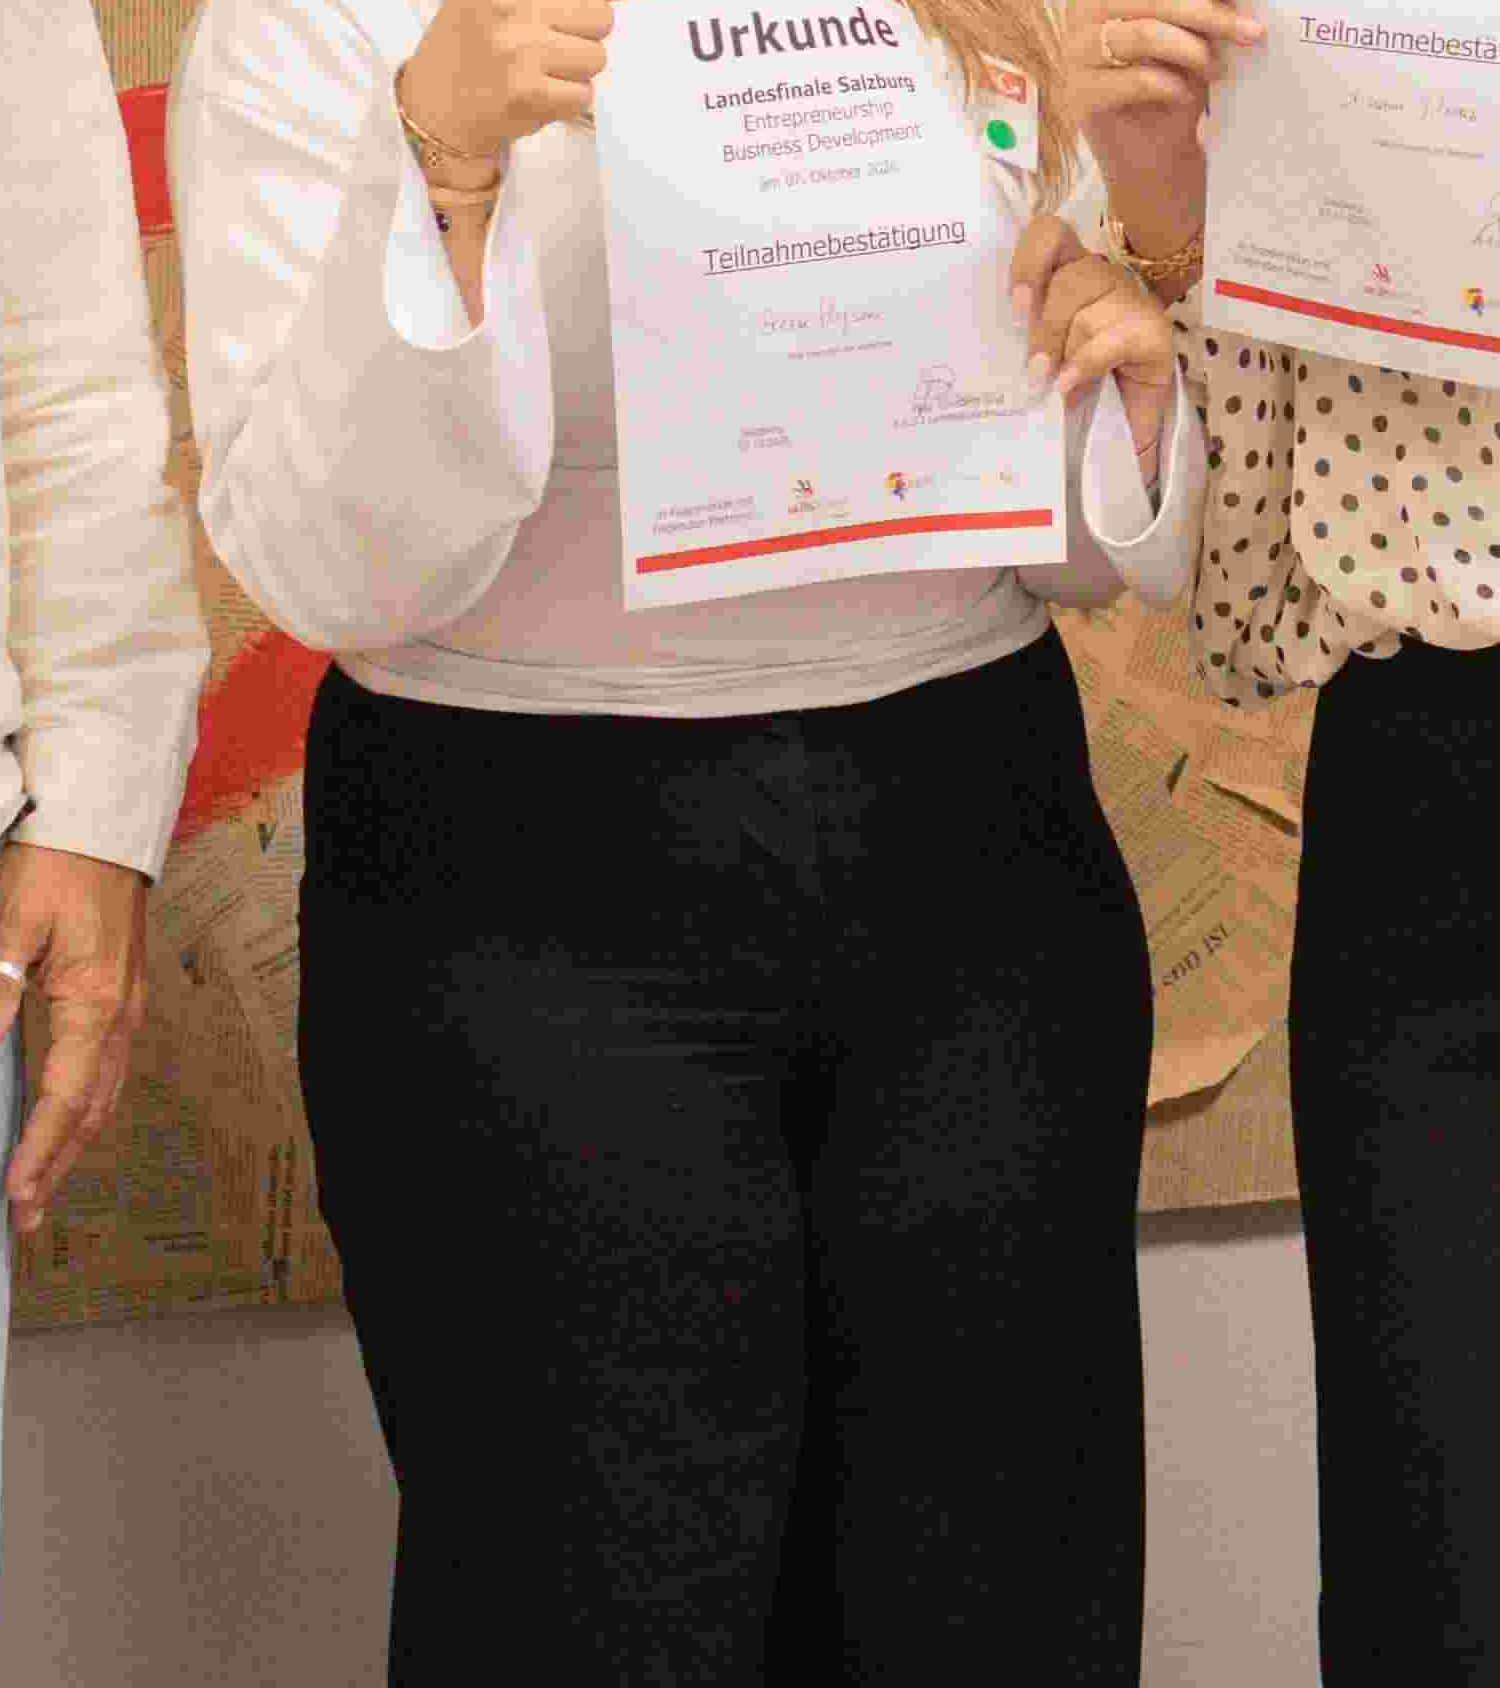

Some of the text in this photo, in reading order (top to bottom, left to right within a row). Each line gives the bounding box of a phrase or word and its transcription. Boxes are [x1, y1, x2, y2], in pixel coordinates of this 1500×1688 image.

[687, 6, 900, 63] Urkunde
[704, 71, 916, 110] Landesfinale Salzburg
[743, 98, 894, 133] Entrepreneurship
[723, 121, 924, 163] Business Development
[702, 220, 966, 275] Teilnahmebestätigung
